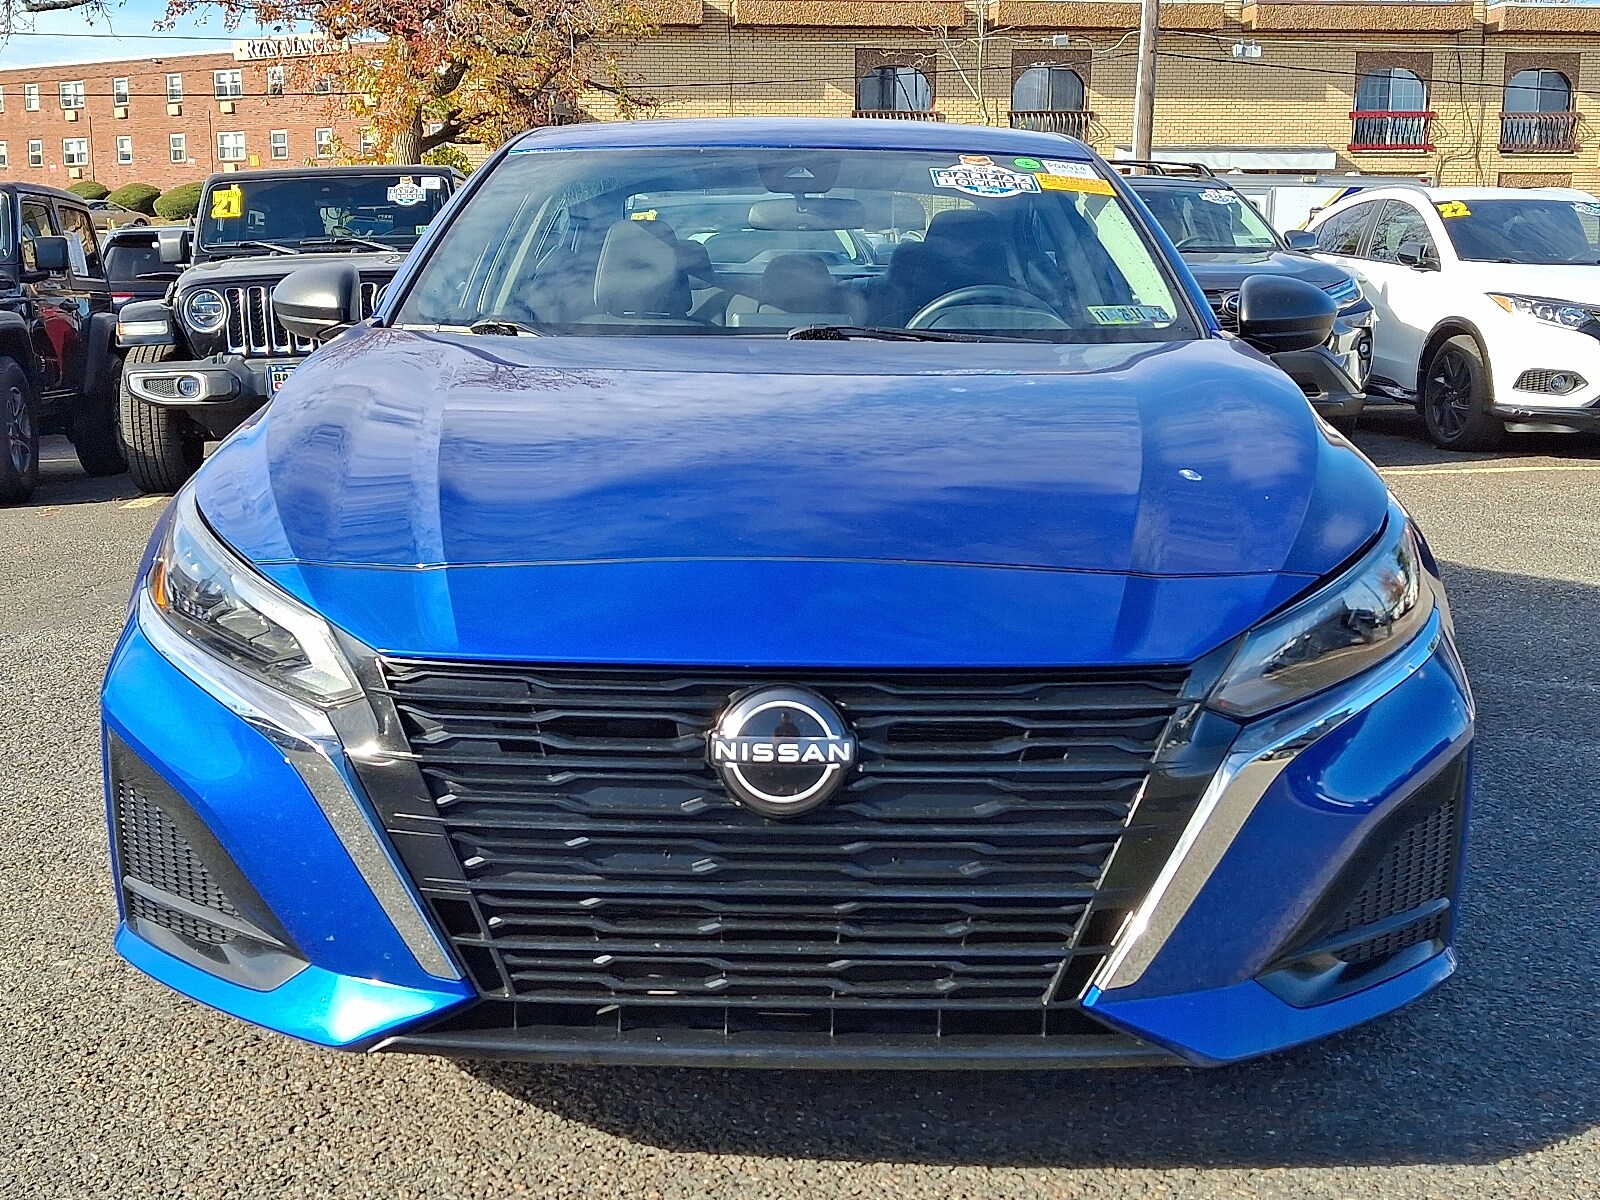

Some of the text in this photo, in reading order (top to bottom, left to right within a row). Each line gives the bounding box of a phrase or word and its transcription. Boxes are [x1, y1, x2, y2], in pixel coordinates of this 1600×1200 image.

[247, 40, 278, 58] RYAN
[211, 197, 241, 218] 21
[705, 740, 850, 763] NISSAN
